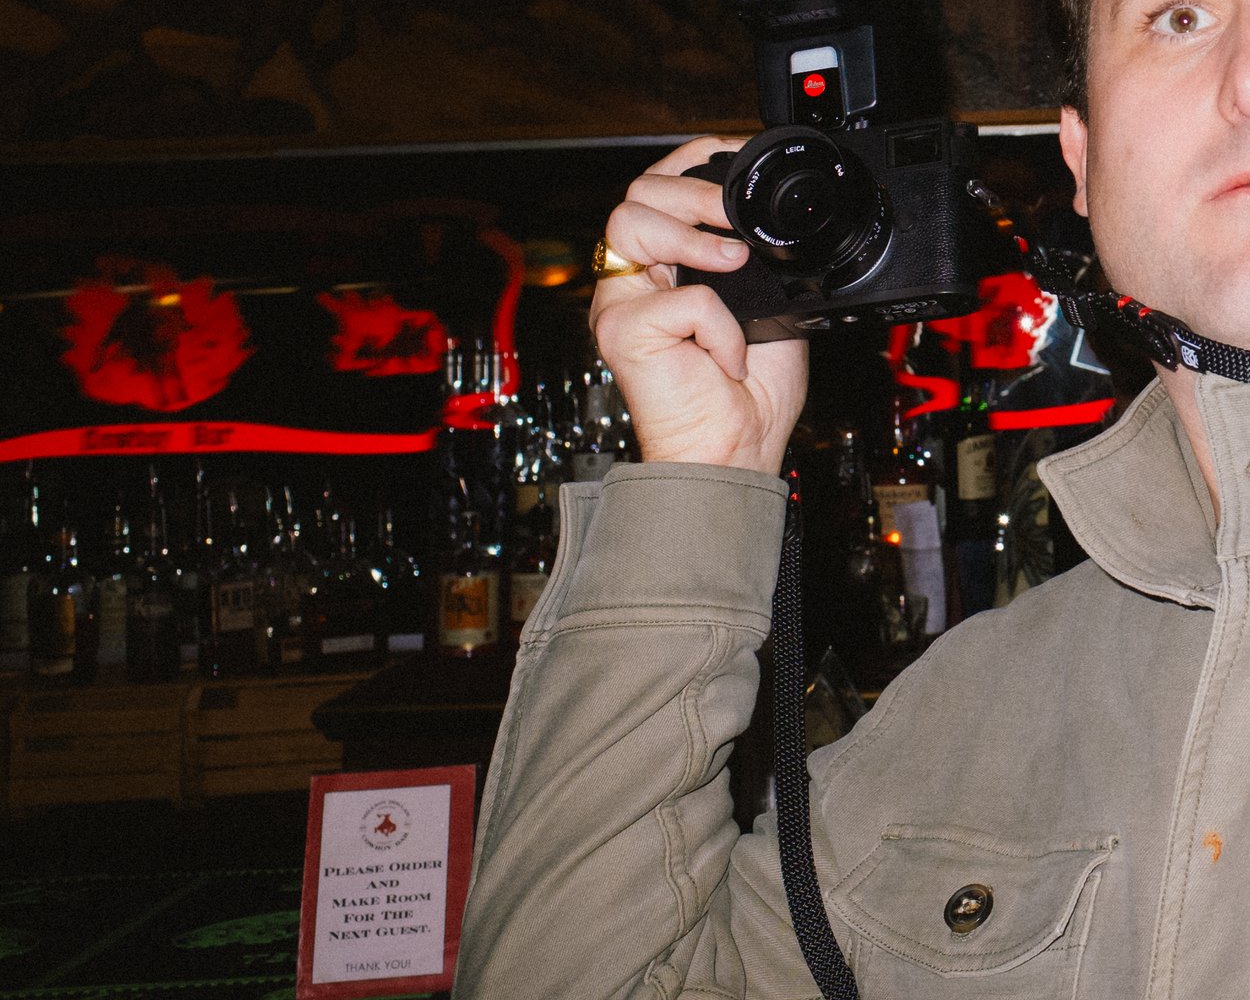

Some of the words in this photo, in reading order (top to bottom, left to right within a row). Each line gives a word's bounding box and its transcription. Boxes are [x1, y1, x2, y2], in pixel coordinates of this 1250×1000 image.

[785, 145, 805, 155] LEICA
[323, 864, 384, 878] PLEASE
[388, 860, 443, 871] ORDER
[365, 879, 400, 890] AND
[331, 896, 381, 909] MAKE
[385, 892, 432, 904] ROOM
[343, 913, 375, 924] FOR
[380, 909, 414, 920] THE
[328, 929, 372, 942] NEXT
[345, 962, 381, 973] THANK
[385, 959, 412, 970] YOU!
